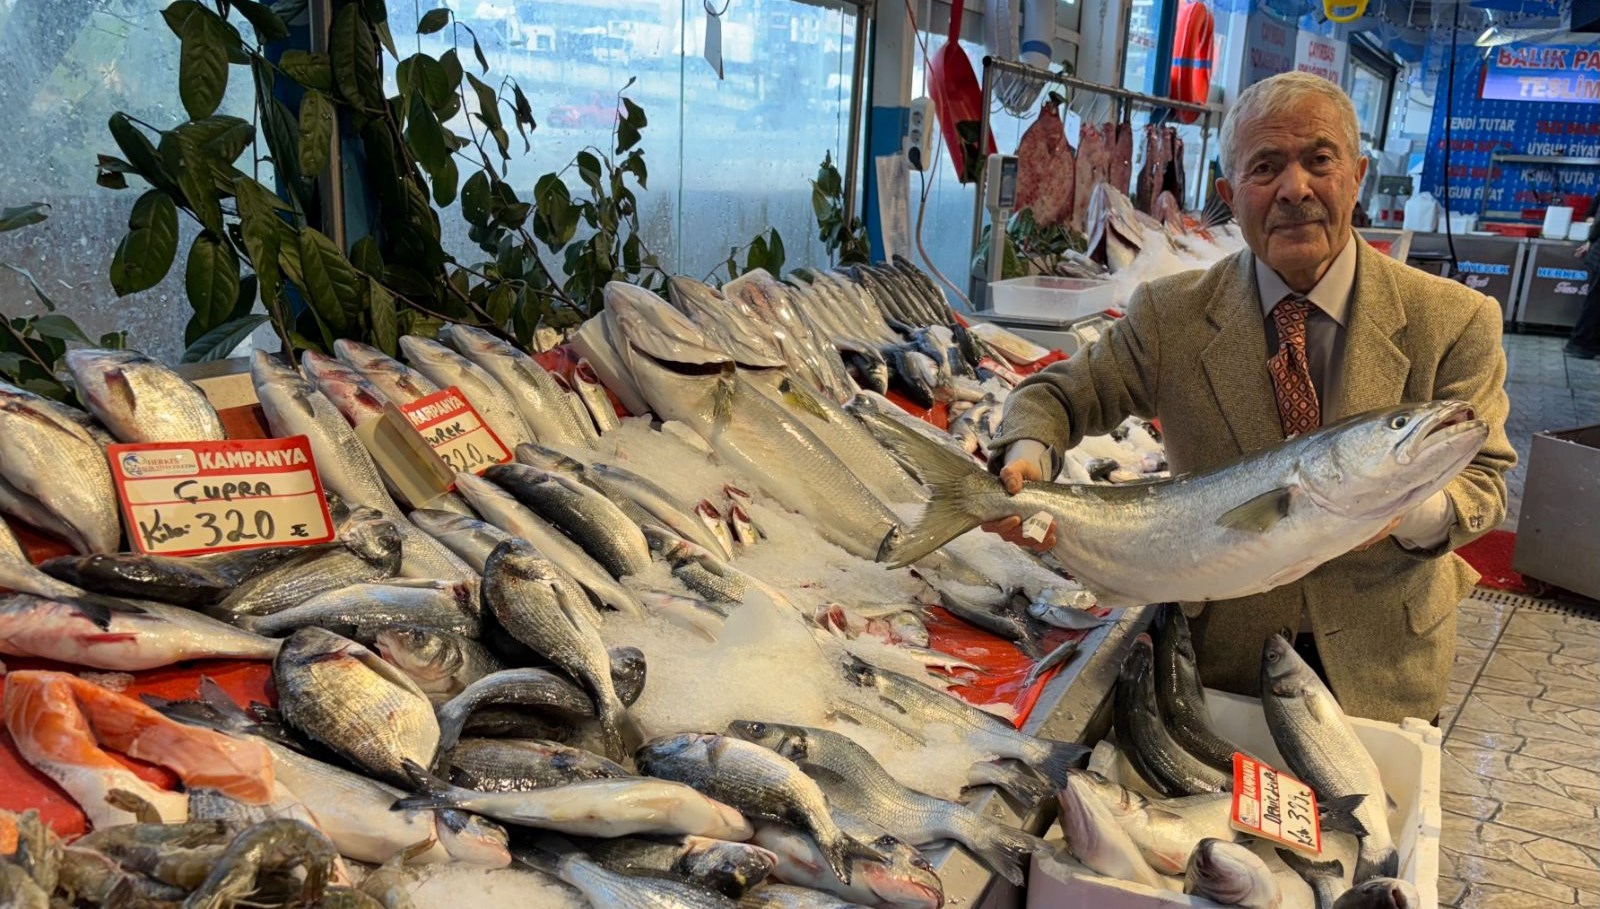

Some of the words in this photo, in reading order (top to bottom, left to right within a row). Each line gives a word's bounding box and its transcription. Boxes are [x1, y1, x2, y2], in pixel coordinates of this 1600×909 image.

[1497, 48, 1569, 69] BALIK
[1573, 49, 1600, 71] PA
[1480, 118, 1516, 131] TUTAR
[1560, 171, 1594, 185] TUTAR
[1434, 185, 1471, 199] UGUN
[1537, 267, 1588, 280] HERKES
[408, 396, 466, 426] KAMPANYA
[199, 447, 307, 470] KAMPANYA
[195, 509, 275, 547] 320
[1242, 759, 1256, 799] KAMPANYA
